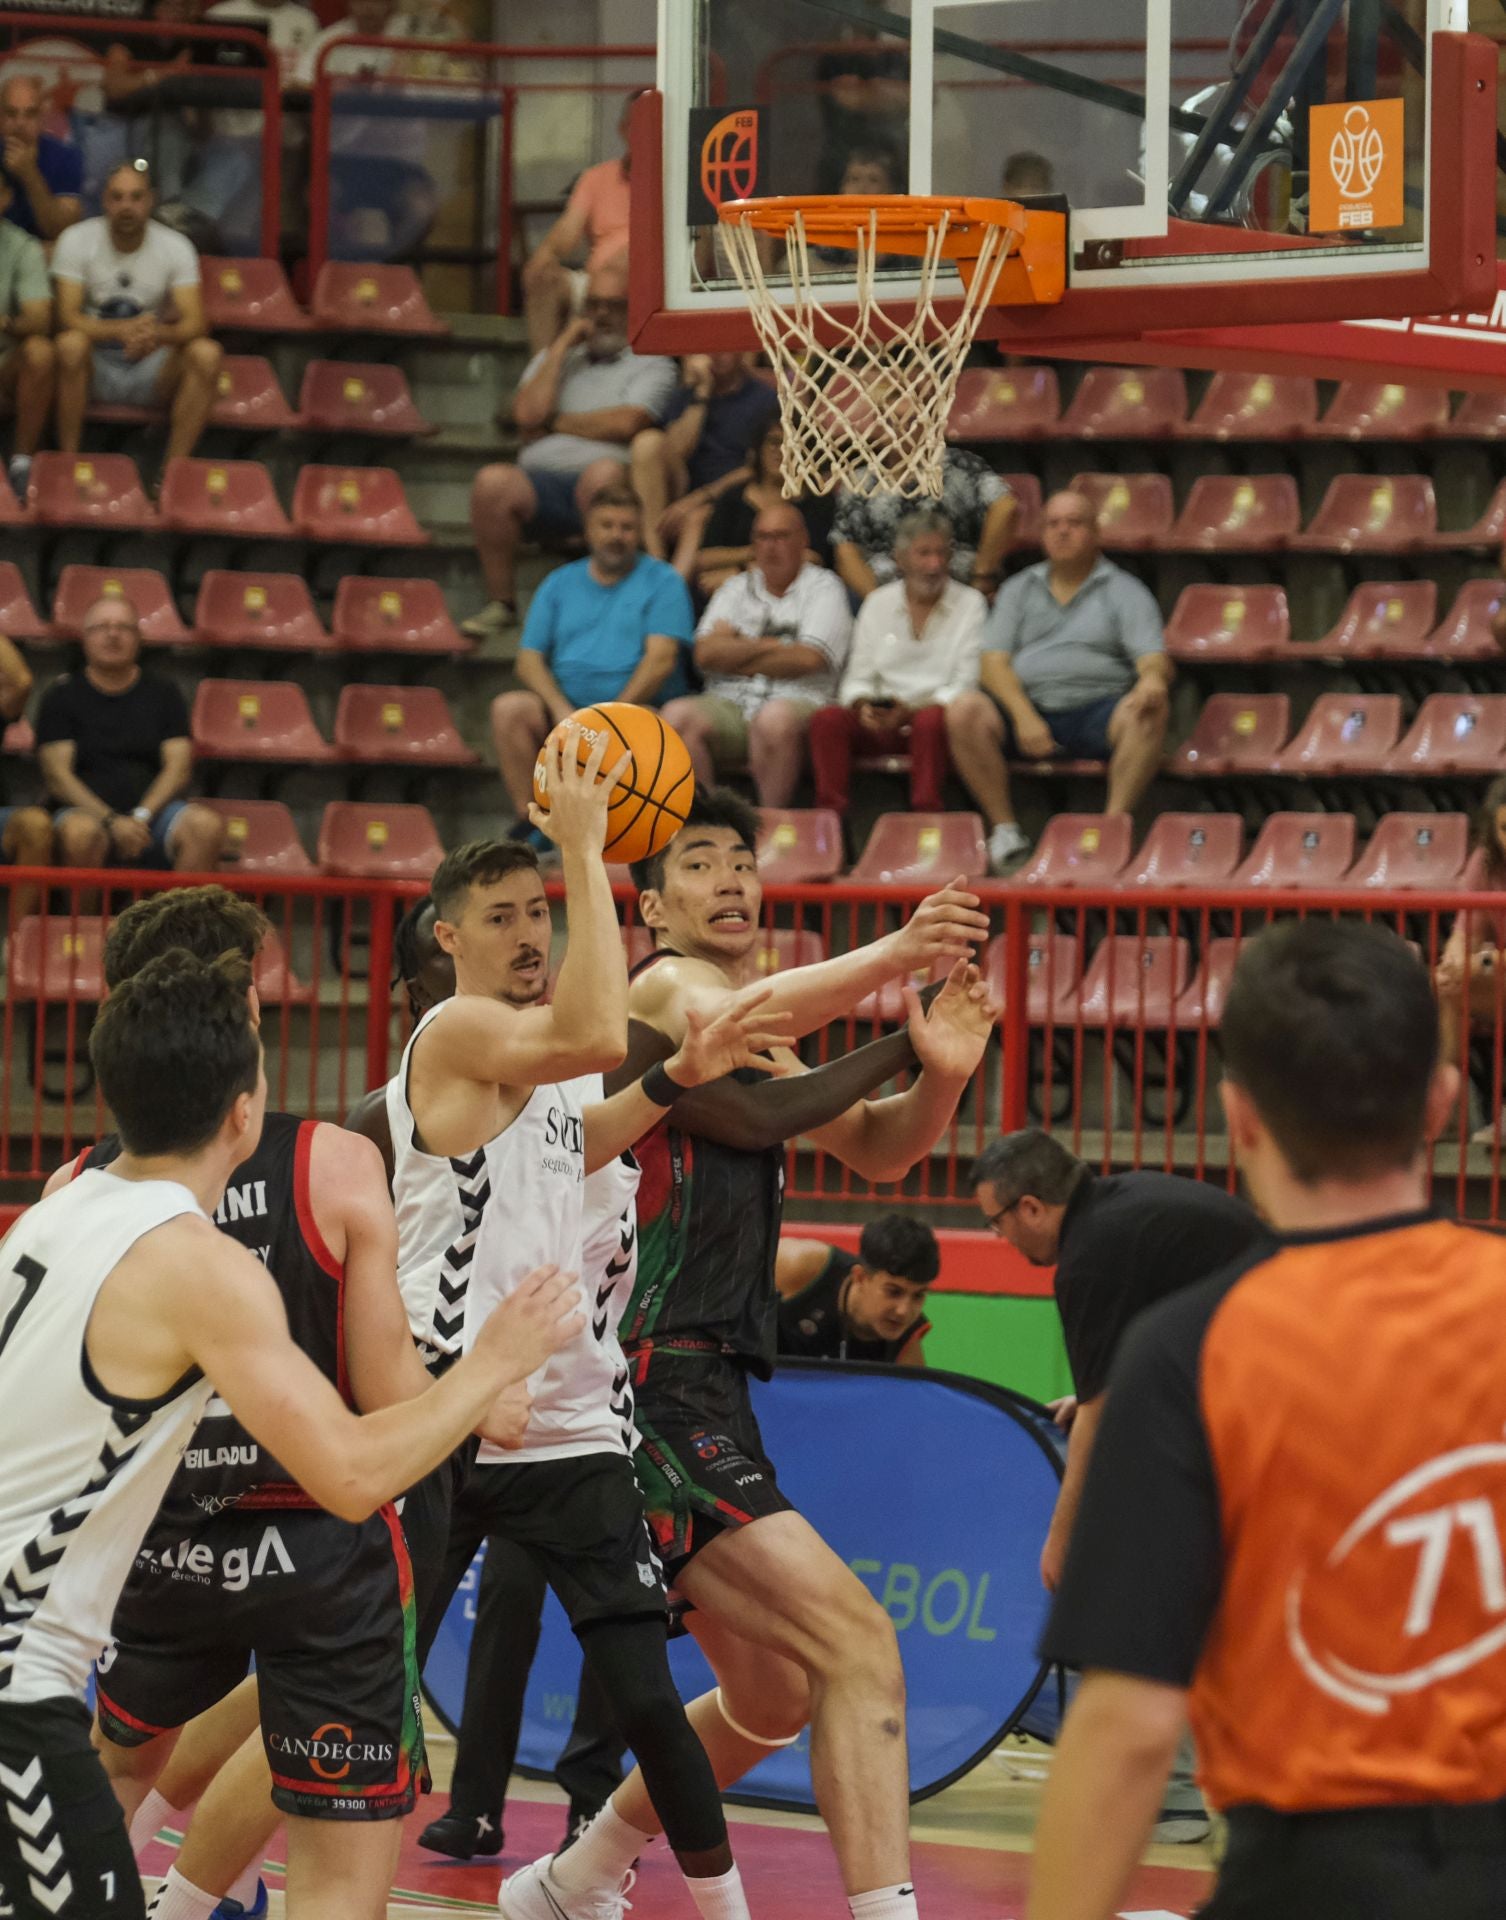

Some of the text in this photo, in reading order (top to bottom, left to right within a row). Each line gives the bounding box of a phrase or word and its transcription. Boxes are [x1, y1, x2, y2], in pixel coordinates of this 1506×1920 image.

[735, 116, 753, 128] FEB
[1339, 210, 1373, 228] FEB
[210, 1180, 268, 1225] INI
[735, 1472, 763, 1486] vive
[1384, 1494, 1506, 1640] 71
[269, 1732, 394, 1762] CANDECRIS
[332, 1798, 366, 1810] 39300
